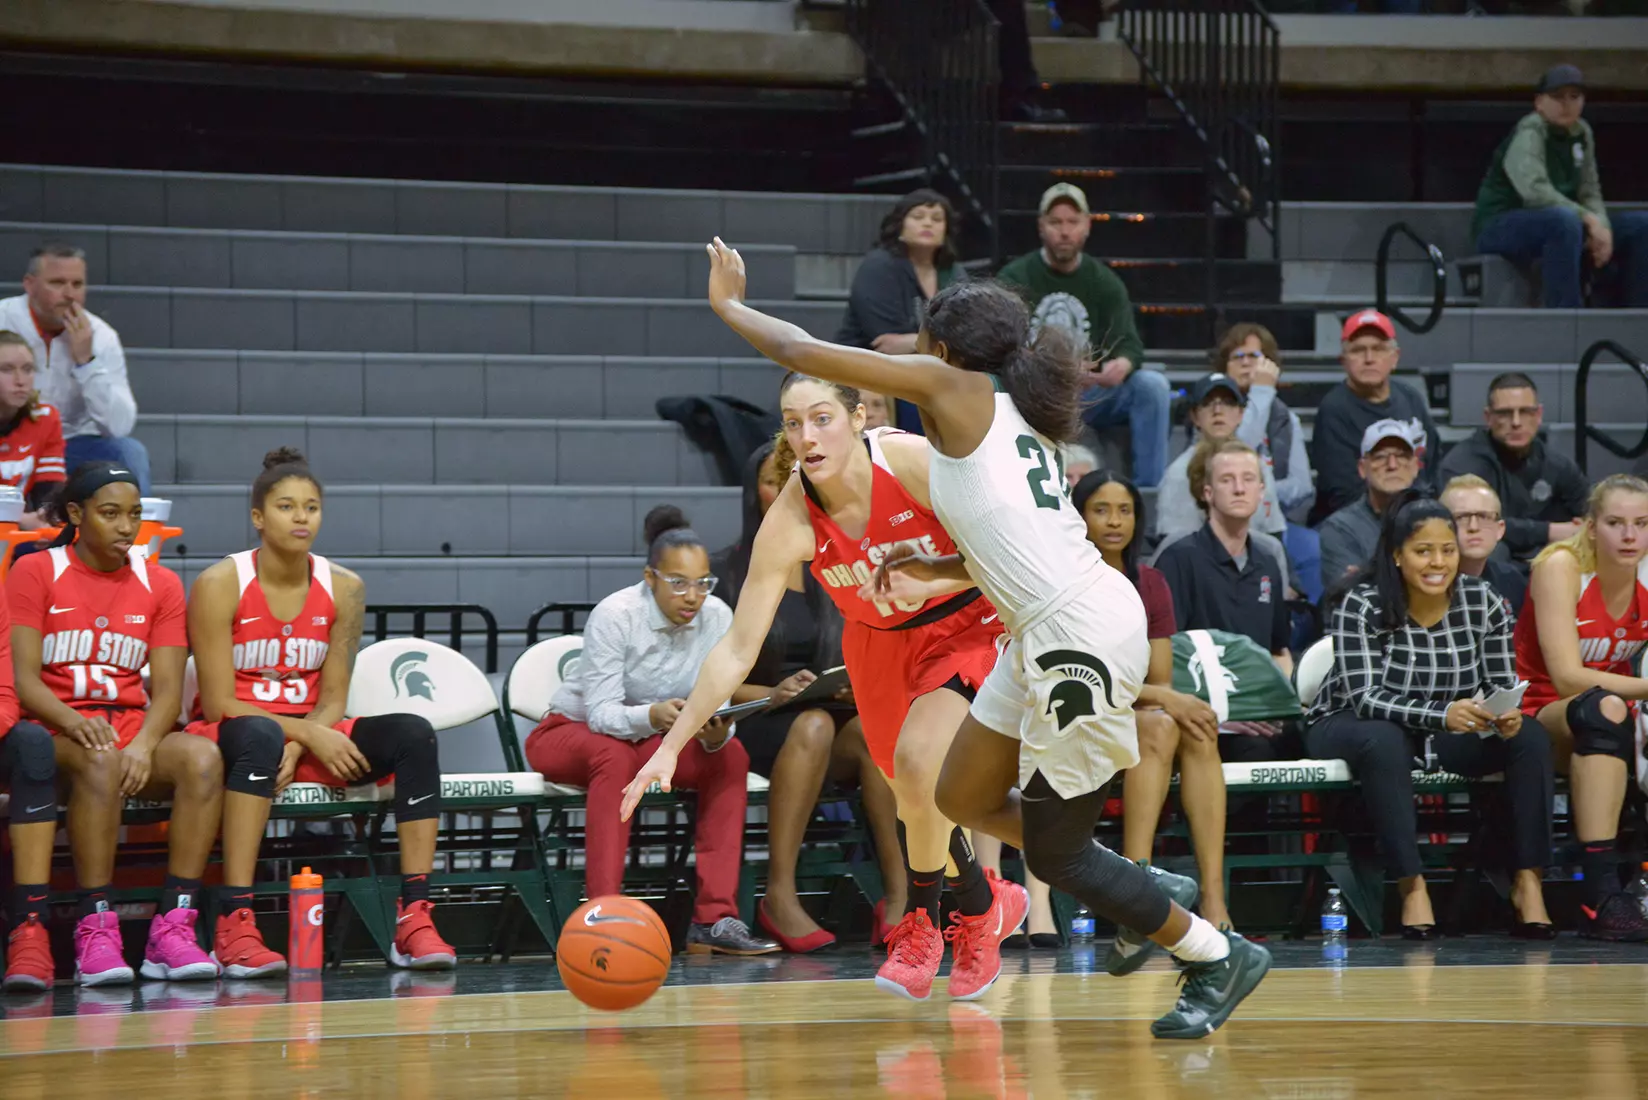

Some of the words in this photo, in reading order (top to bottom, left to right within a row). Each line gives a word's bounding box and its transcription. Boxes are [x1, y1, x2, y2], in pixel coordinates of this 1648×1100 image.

[42, 629, 94, 665] OHIO
[233, 638, 281, 670] OHIO
[284, 637, 329, 671] STAT
[67, 664, 118, 701] 15
[1251, 766, 1327, 784] SPARTANS
[273, 786, 346, 803] ARTANS
[442, 780, 514, 797] PARTANS
[308, 904, 324, 926] G
